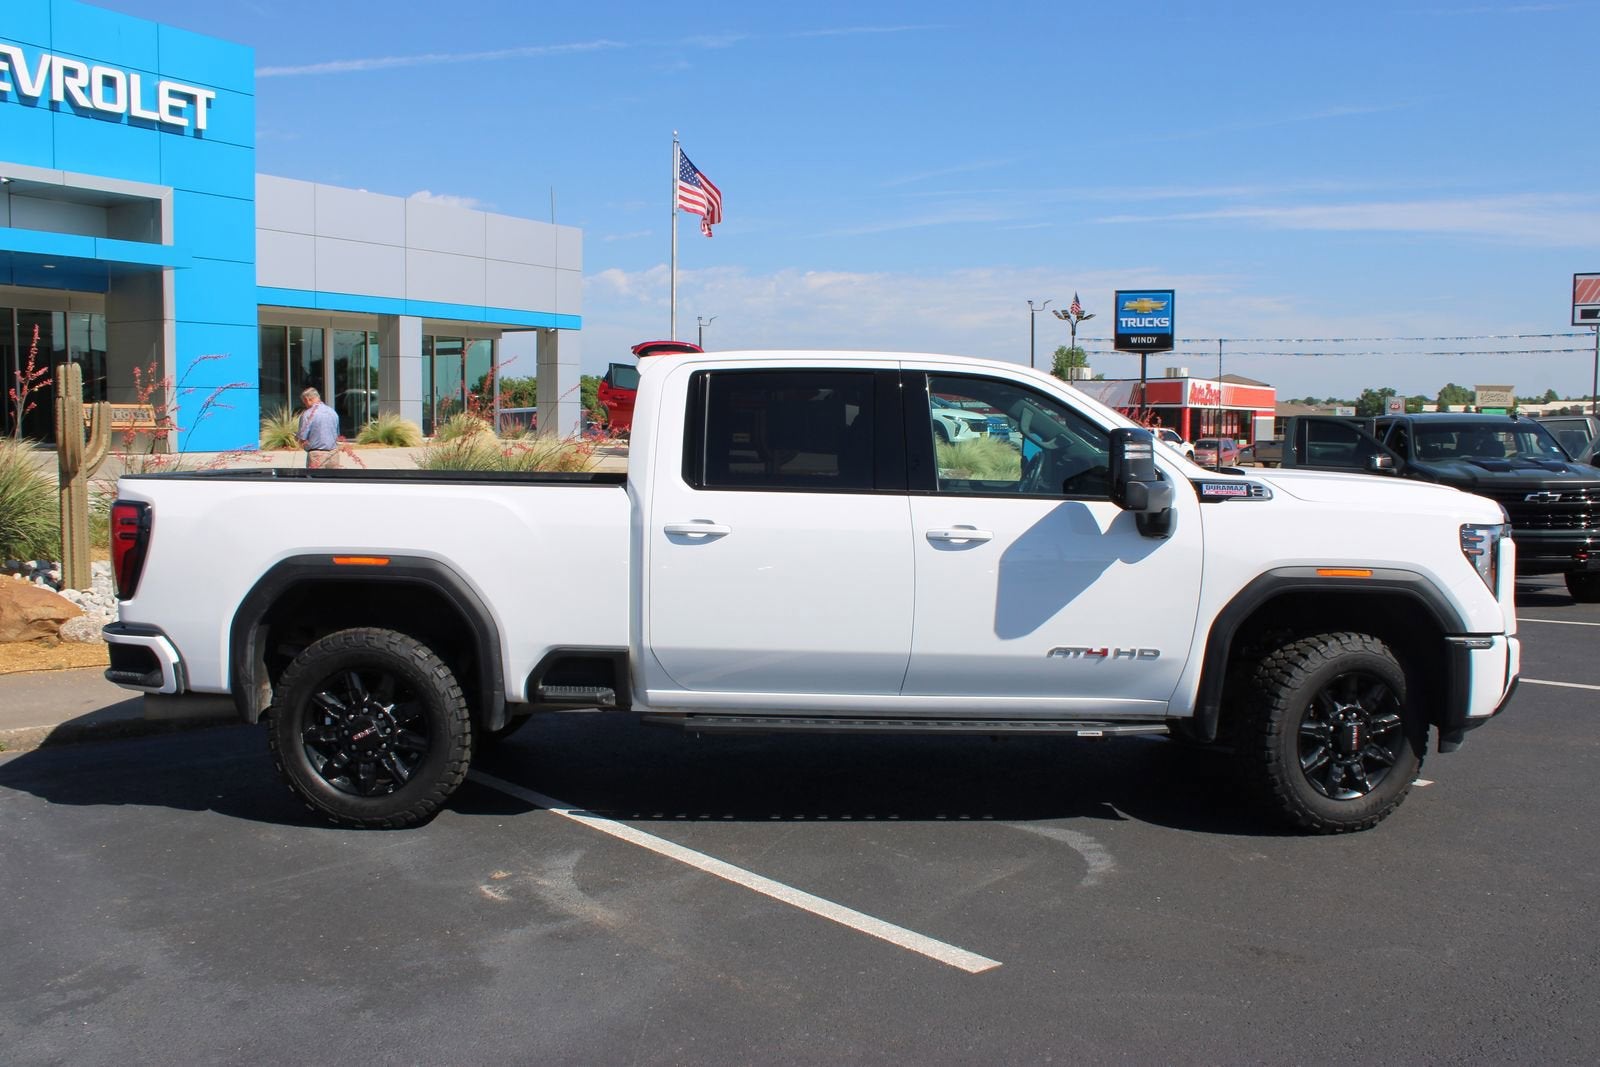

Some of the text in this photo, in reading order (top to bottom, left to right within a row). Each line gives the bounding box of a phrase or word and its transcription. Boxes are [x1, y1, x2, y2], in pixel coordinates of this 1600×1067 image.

[1120, 317, 1169, 327] TRUCKS
[1047, 647, 1160, 659] AT4 HD
